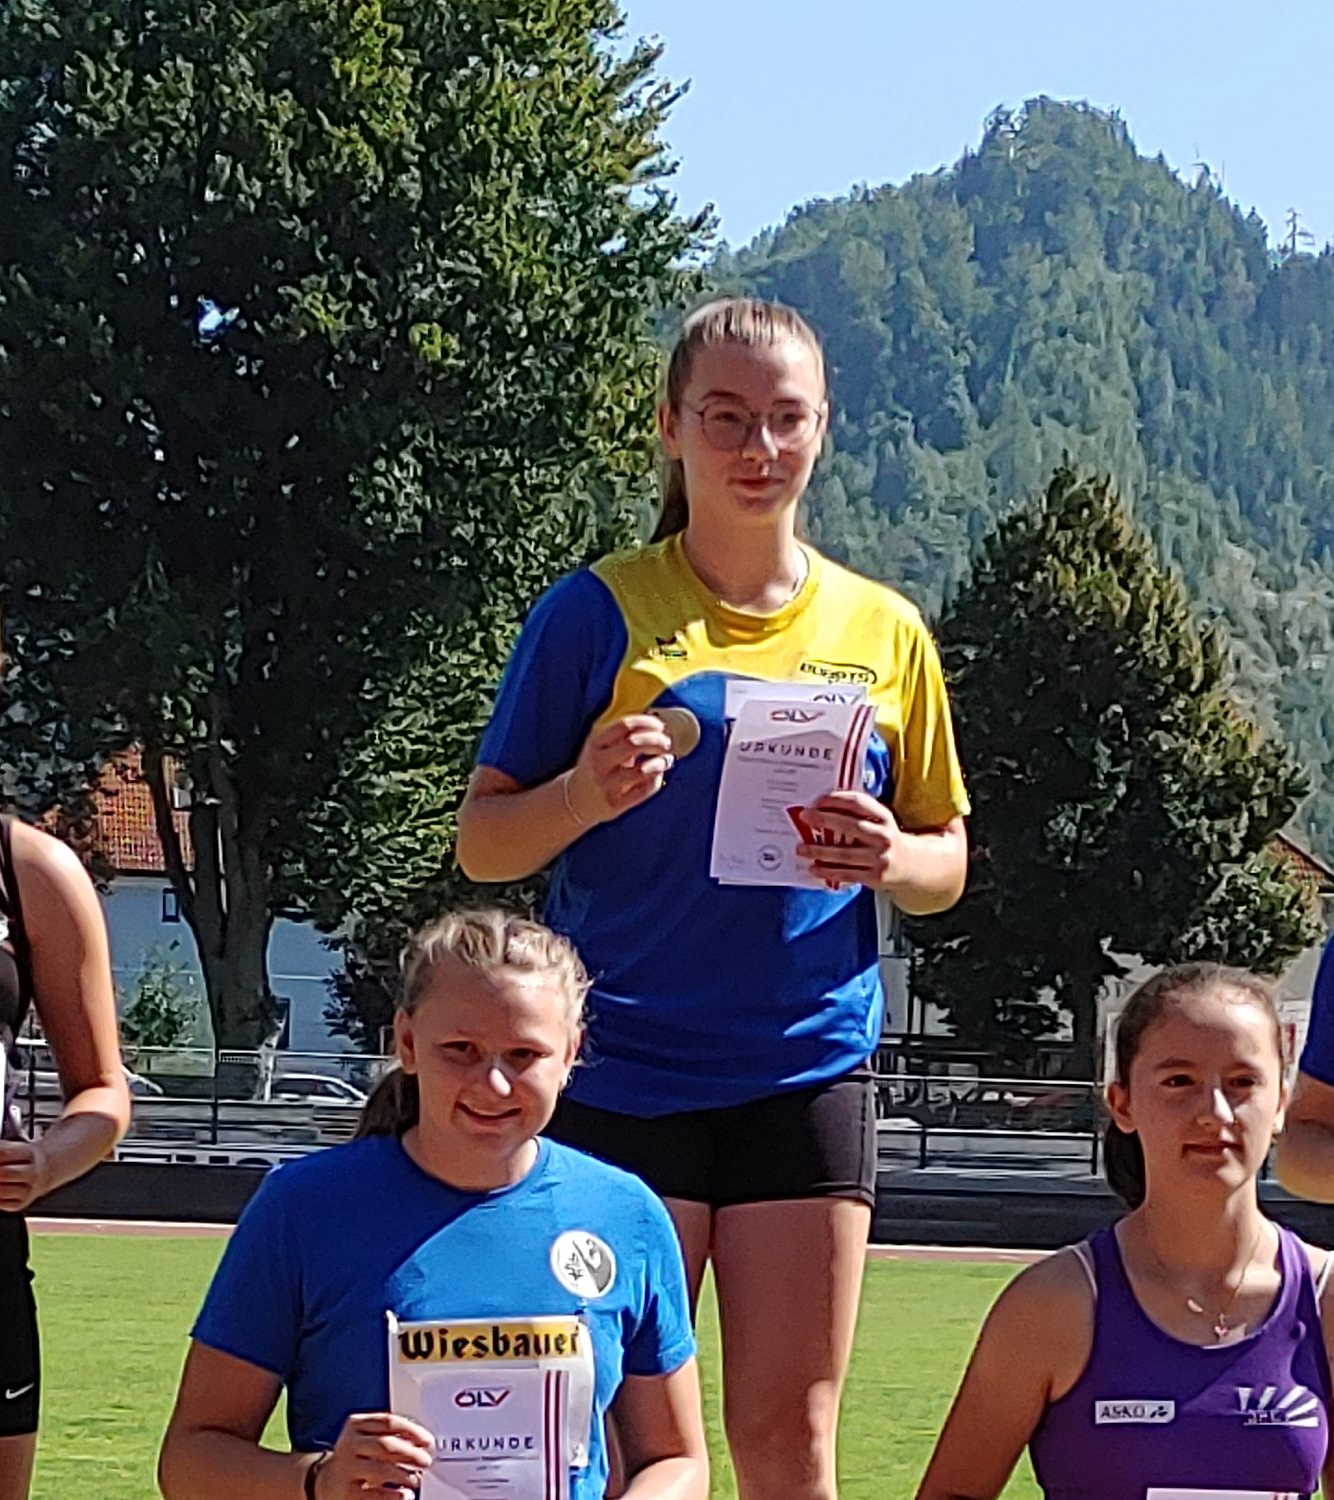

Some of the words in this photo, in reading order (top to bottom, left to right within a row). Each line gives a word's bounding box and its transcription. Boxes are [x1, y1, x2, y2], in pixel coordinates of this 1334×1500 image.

[739, 741, 834, 761] URKUNDE
[398, 1326, 580, 1360] Wiesbauer
[435, 1436, 534, 1451] URKUNDE
